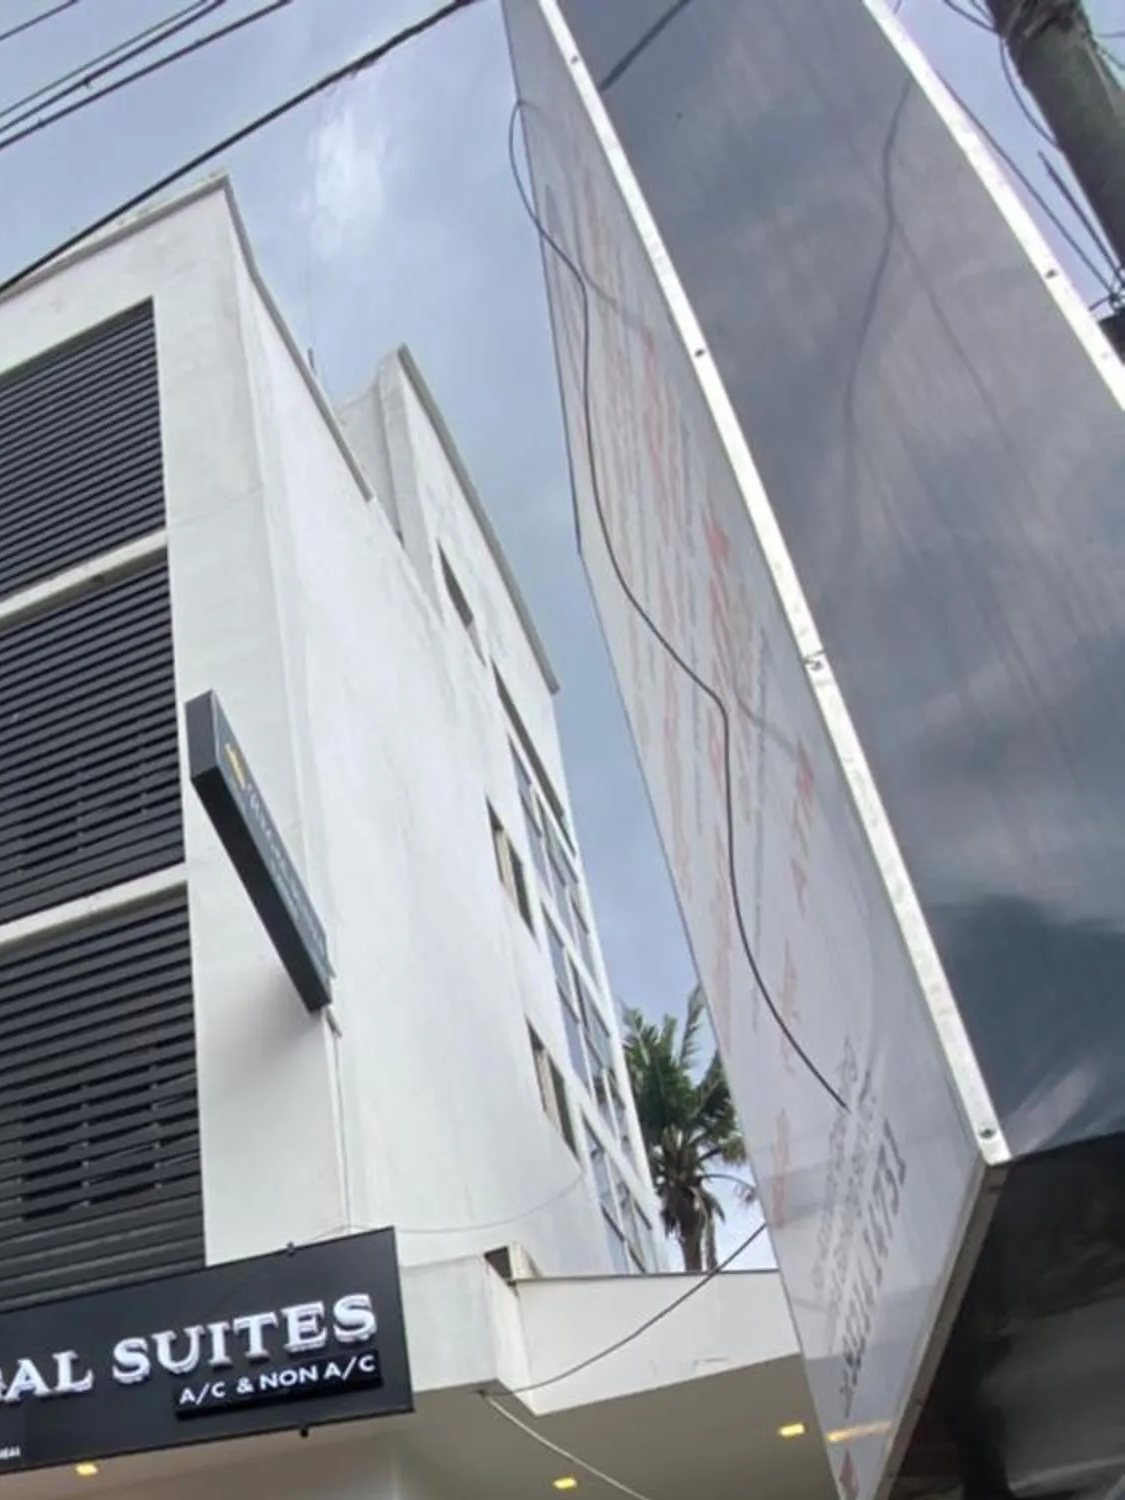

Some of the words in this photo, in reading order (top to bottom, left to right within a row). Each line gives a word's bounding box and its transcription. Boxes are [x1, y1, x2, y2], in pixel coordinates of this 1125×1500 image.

[111, 1293, 378, 1381] SUITES
[179, 1381, 226, 1406] A/C
[236, 1377, 254, 1395] &
[260, 1365, 319, 1389] NON
[323, 1355, 376, 1381] A/C
